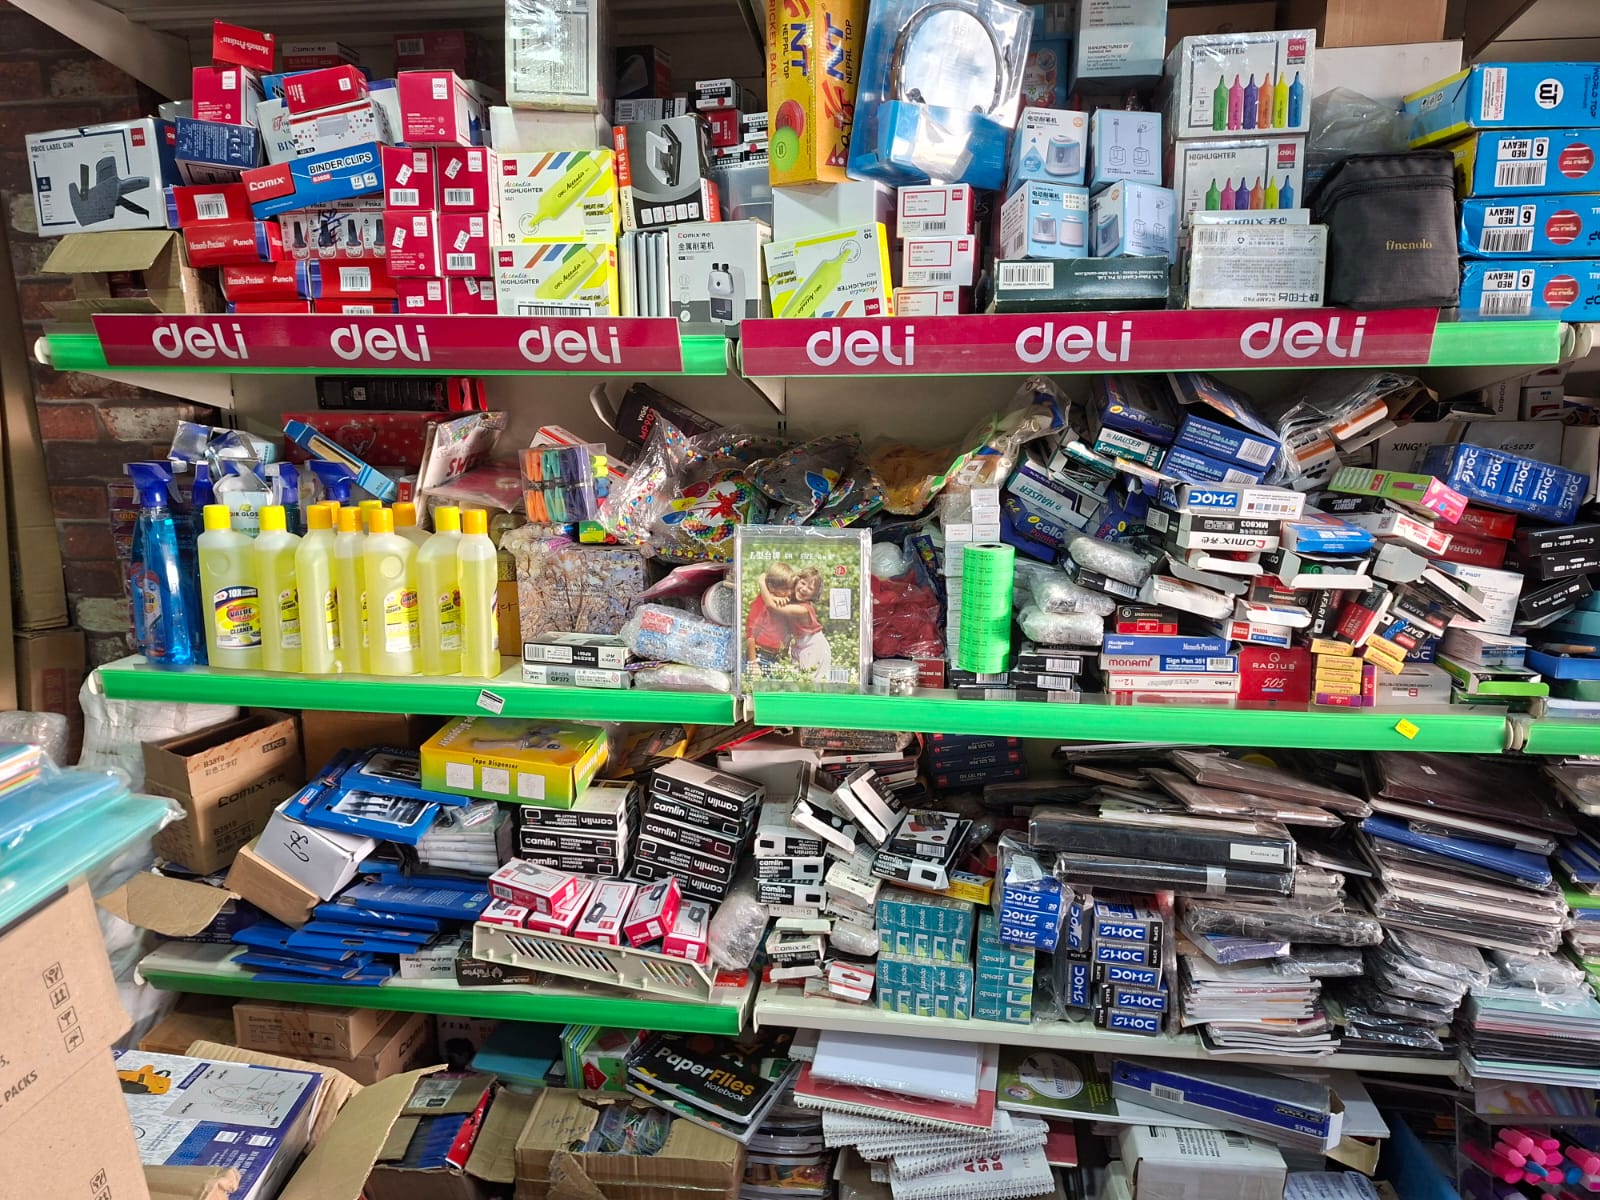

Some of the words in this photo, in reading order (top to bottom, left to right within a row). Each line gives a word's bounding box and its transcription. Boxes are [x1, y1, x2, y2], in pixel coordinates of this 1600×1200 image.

[769, 53, 777, 88] BALL
[1502, 141, 1528, 149] HEAVY
[1536, 143, 1545, 157] 6
[1188, 152, 1237, 160] HIGHLIGHTER
[308, 159, 344, 175] BINDER
[344, 152, 373, 168] CLIPS
[249, 176, 285, 192] Comix
[1489, 208, 1516, 216] HEAVY
[1523, 210, 1532, 223] 6
[272, 275, 293, 283] Punch
[837, 279, 878, 292] HIGHLIGHTER
[1522, 275, 1531, 287] 6
[151, 322, 249, 361] deli
[330, 322, 431, 363] deli
[517, 322, 621, 364] deli
[1014, 320, 1131, 363] deli
[1239, 316, 1367, 359] deli
[805, 326, 915, 367] deli
[1111, 433, 1145, 448] HAUSER
[1019, 484, 1056, 509] HAUSER
[1188, 492, 1236, 505] DOMS
[1034, 521, 1063, 540] cello
[228, 588, 242, 598] 10X
[230, 626, 254, 635] CLEANER
[1108, 657, 1152, 667] monami
[1261, 678, 1288, 689] 505
[472, 757, 487, 767] Tape
[488, 759, 519, 770] Dispenser
[654, 801, 685, 817] camlin
[707, 796, 739, 812] camlin
[581, 816, 613, 825] camlin
[646, 823, 677, 839] camlin
[525, 837, 556, 847] camlin
[878, 853, 903, 865] camlin
[694, 859, 725, 874] camlin
[691, 878, 723, 893] camlin
[1005, 890, 1043, 903] DOMS
[1002, 909, 1040, 922] DOMS
[1002, 926, 1040, 940] DOMS
[1101, 926, 1144, 939] DOMS
[1100, 949, 1143, 962] DOMS
[1111, 968, 1154, 983] DOMS
[1074, 966, 1085, 1003] DOMS
[1120, 994, 1163, 1008] DOMS
[1113, 1017, 1156, 1030] DOMS
[4, 1070, 38, 1102] PACKS
[703, 1080, 746, 1101] Notebook
